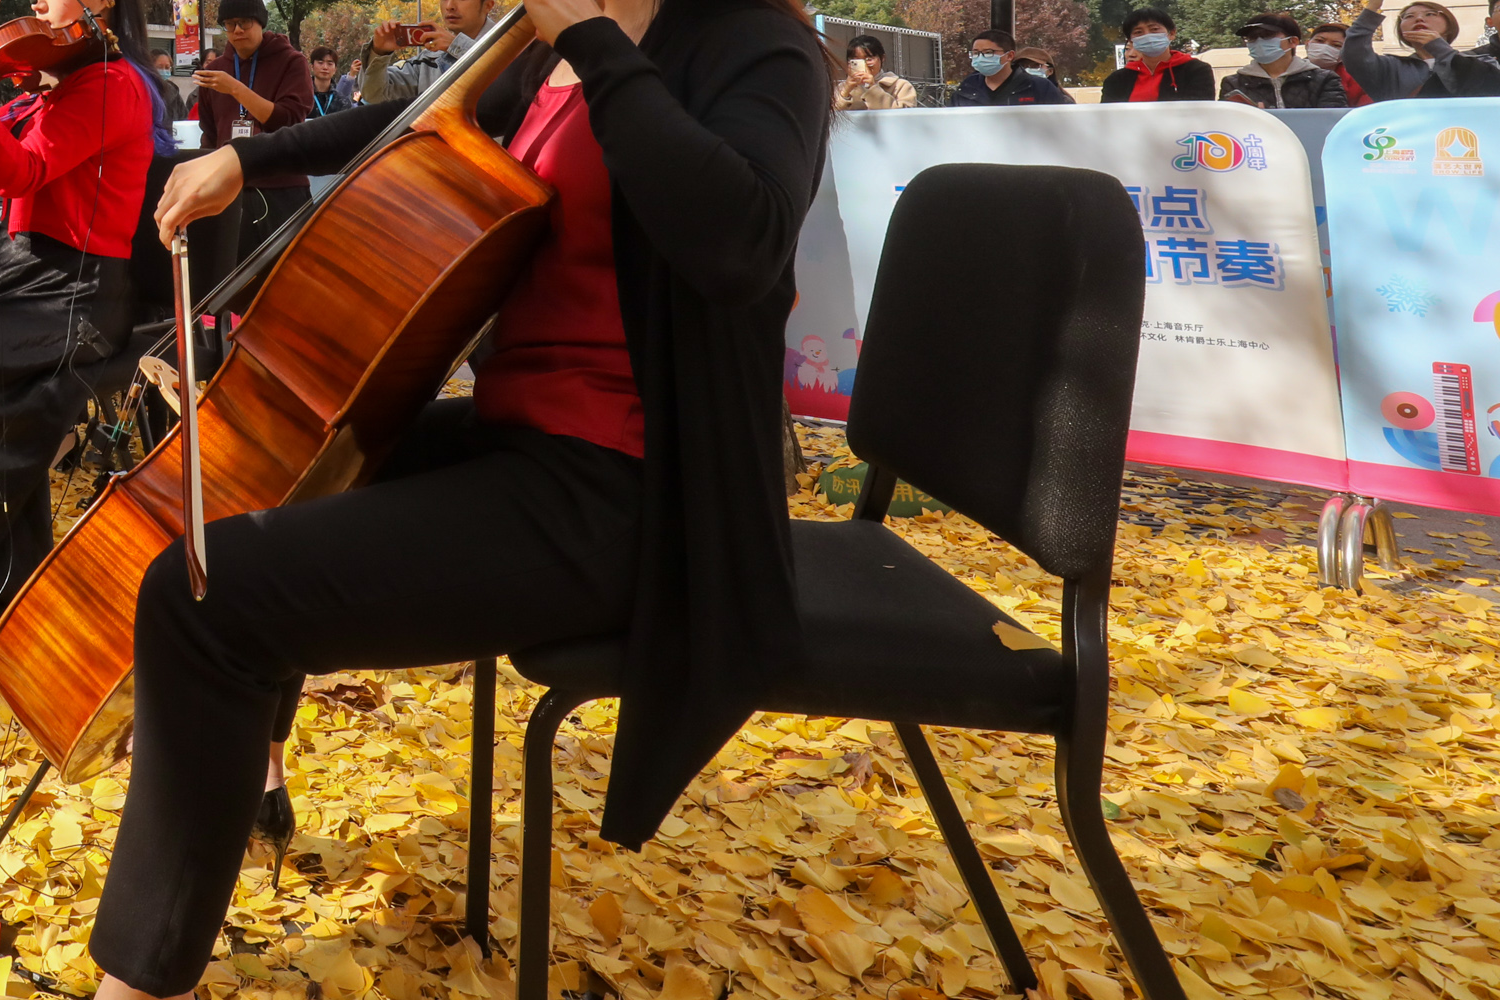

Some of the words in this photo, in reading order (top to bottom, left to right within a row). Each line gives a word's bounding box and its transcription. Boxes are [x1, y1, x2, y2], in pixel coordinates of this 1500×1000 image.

[1175, 335, 1270, 351] 林肯爵士乐上海中心
